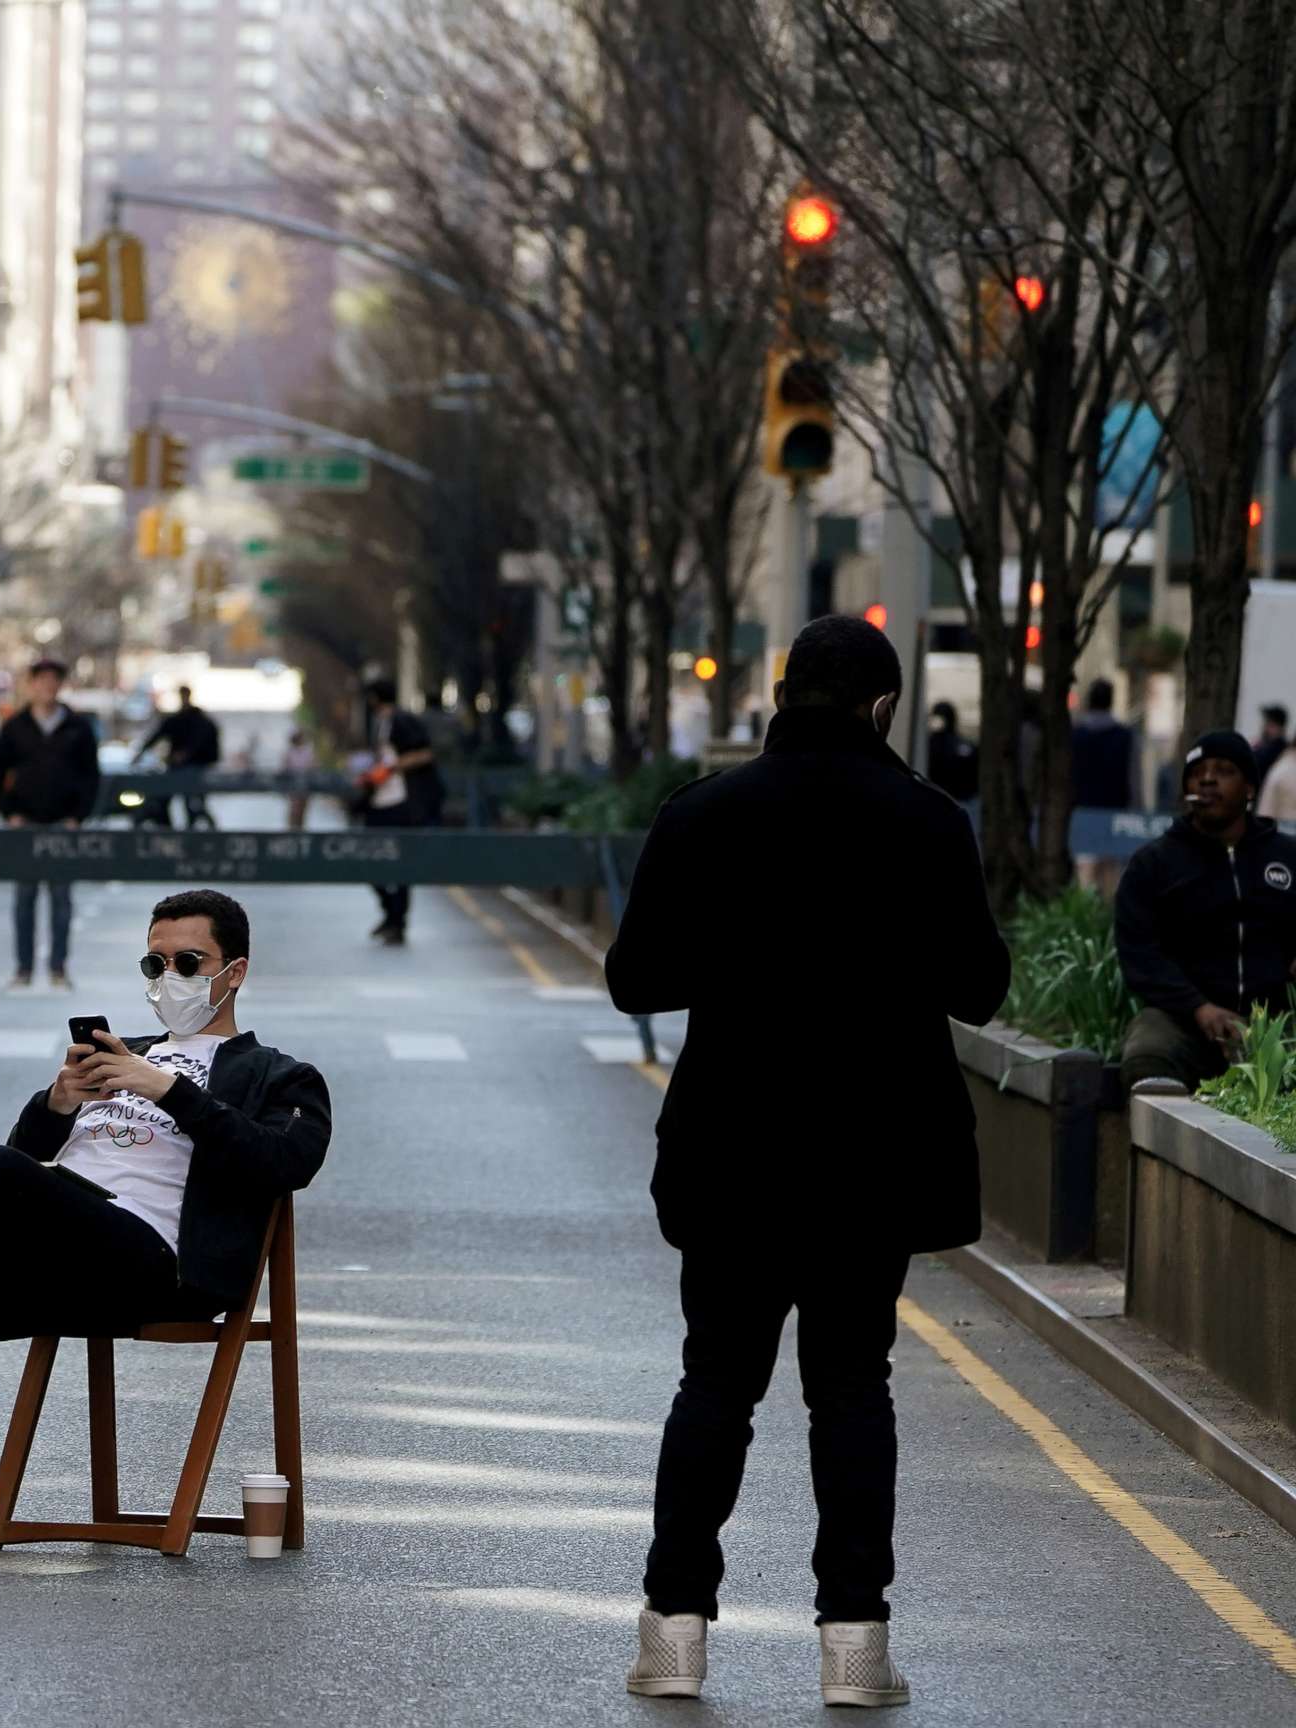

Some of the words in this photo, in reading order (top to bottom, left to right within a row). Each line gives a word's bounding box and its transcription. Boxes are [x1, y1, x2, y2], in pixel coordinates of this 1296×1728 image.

[1111, 813, 1172, 839] POLIC
[32, 836, 113, 858] POLICE
[136, 836, 188, 859] LINE
[224, 836, 258, 860] DO
[268, 836, 312, 860] NOT
